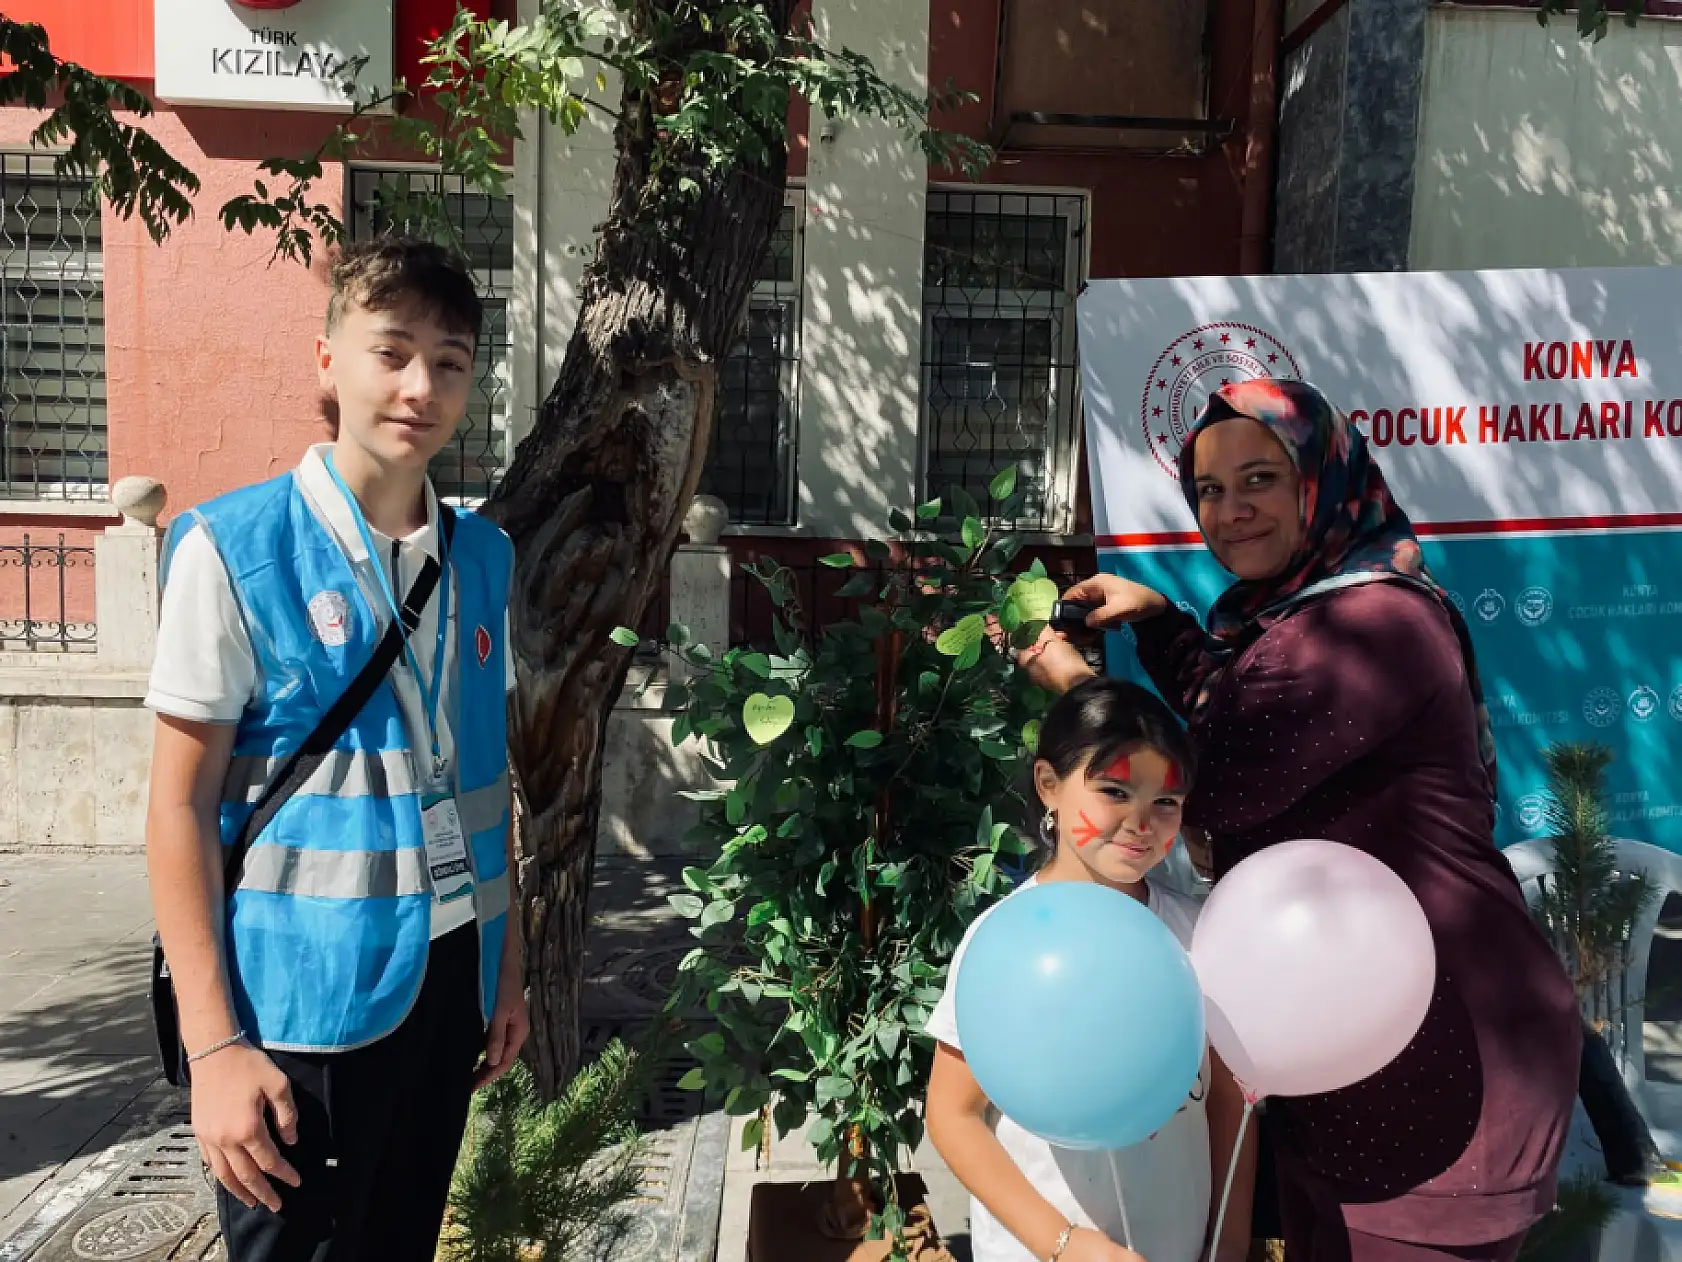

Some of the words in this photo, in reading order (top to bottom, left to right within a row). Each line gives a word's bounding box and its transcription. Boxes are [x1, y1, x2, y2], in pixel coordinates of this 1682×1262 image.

[250, 26, 298, 46] TÜRK
[212, 47, 334, 79] KIZILAY
[1523, 339, 1639, 381] KONYA
[1479, 401, 1632, 443] HAKLARI
